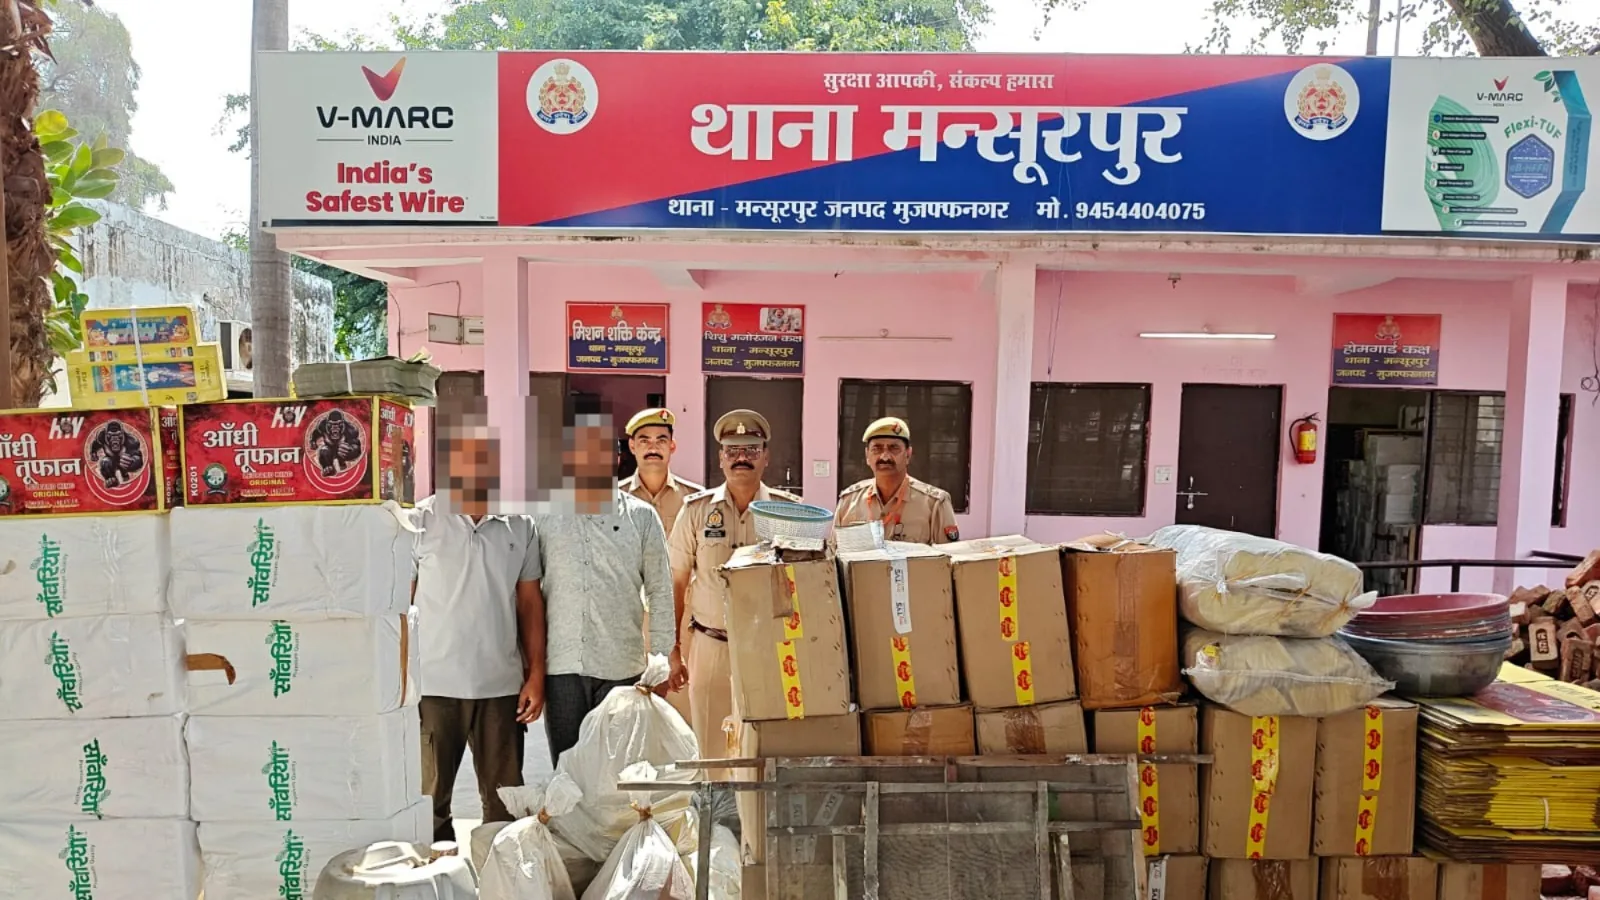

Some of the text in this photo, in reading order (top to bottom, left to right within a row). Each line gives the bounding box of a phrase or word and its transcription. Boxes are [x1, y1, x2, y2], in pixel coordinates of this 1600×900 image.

[823, 69, 1055, 94] सुरक्षा आपकी, संकल्प हमारा
[1476, 92, 1524, 102] V-MARC
[316, 106, 454, 129] V-MARC
[1503, 115, 1562, 139] Flexi-TUF
[367, 135, 402, 146] INDIA
[690, 103, 1189, 186] थाना मन्सूरपुर
[337, 160, 433, 184] India's
[306, 189, 465, 213] Safest Wire
[668, 199, 715, 217] थाना
[735, 200, 819, 224] मन्सूरपुर
[823, 201, 887, 219] जनपद
[1075, 201, 1207, 221] 9454404075
[572, 319, 662, 345] मिशन शक्ति केन्द्र
[730, 331, 777, 342] मनोरंजन
[1343, 340, 1398, 355] होमगार्ड
[14, 458, 82, 485] तूफान
[234, 446, 302, 474] तूफान
[189, 466, 198, 497] K0201
[32, 490, 70, 498] ORIGINAL
